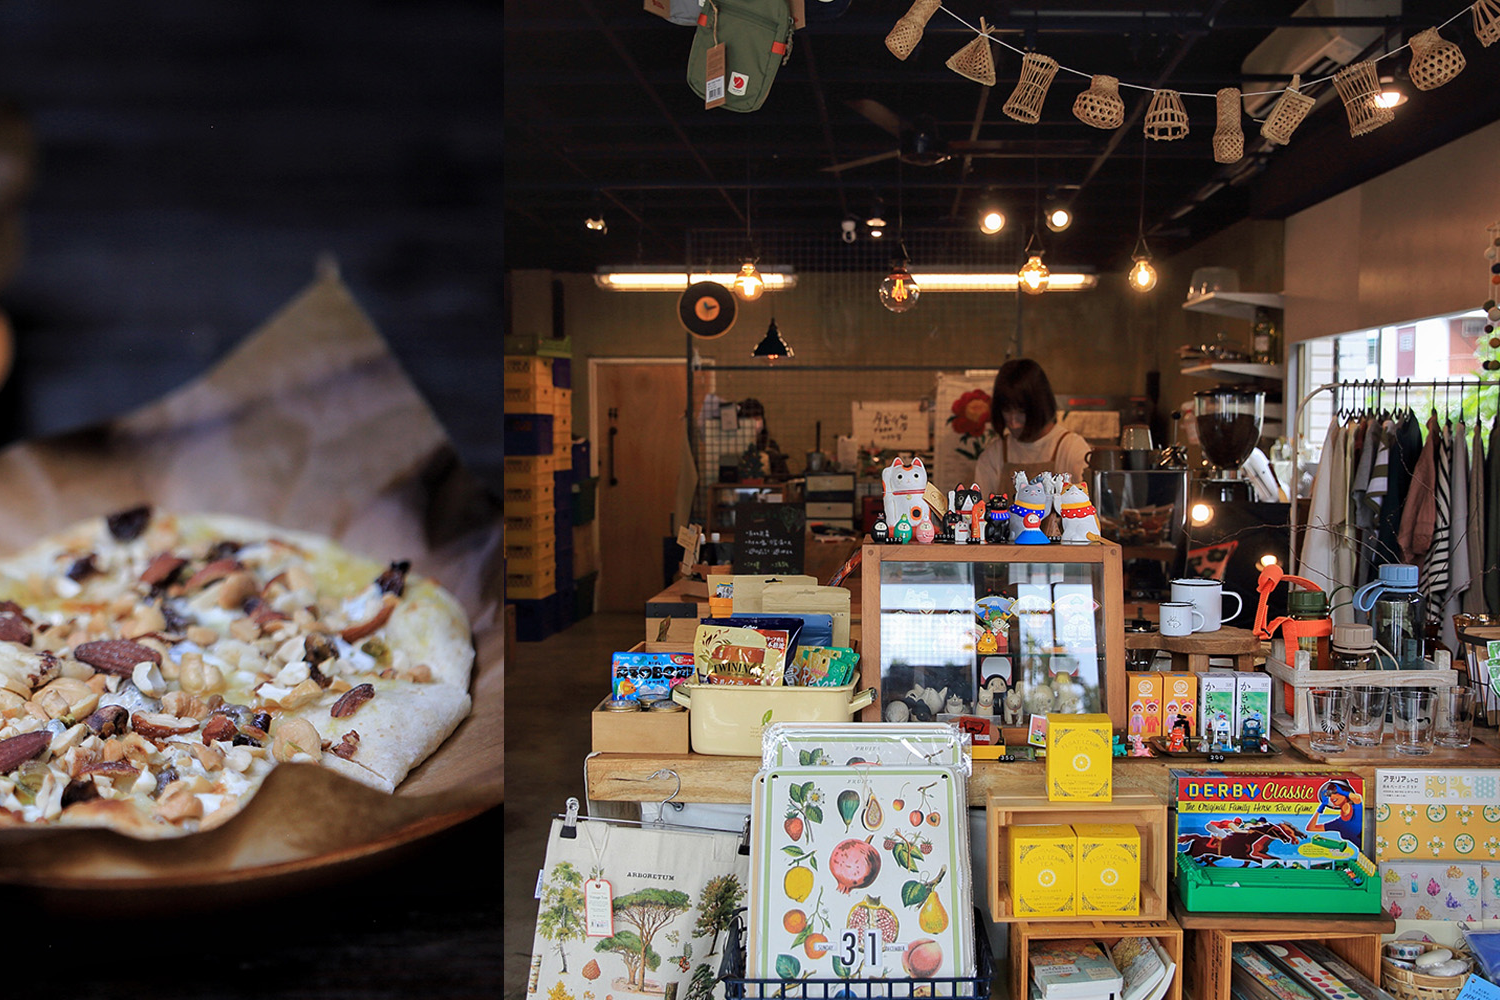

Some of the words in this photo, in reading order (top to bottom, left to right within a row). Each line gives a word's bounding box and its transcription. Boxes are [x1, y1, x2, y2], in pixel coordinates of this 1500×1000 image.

[713, 661, 762, 677] TWININ
[1188, 783, 1259, 798] DERBY
[1262, 781, 1314, 800] Classic
[1185, 802, 1196, 811] The
[1198, 802, 1227, 813] Original
[1229, 802, 1251, 814] Family
[1253, 802, 1273, 812] Horse
[1275, 803, 1292, 812] Race
[1294, 803, 1313, 816] Game
[626, 872, 675, 881] ARBORETUM
[817, 943, 834, 951] SUNDAY
